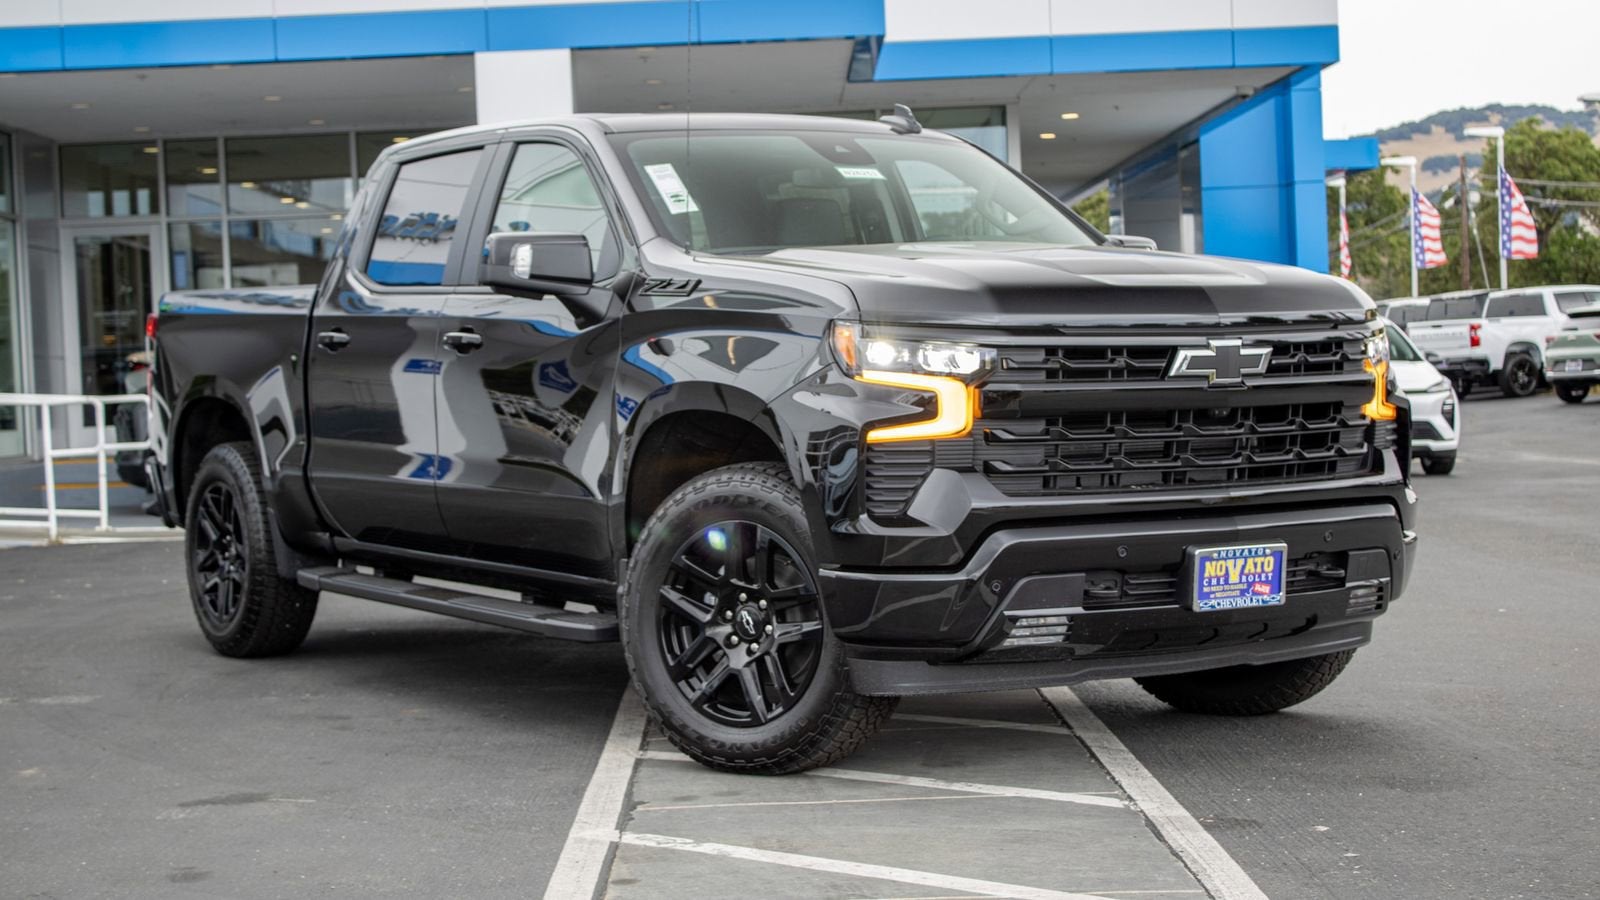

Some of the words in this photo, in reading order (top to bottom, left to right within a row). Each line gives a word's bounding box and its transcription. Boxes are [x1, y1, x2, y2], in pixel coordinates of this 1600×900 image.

[1220, 548, 1264, 558] NOVATO
[1204, 556, 1274, 584] NOVATO
[1214, 597, 1263, 609] CHEVROLET
